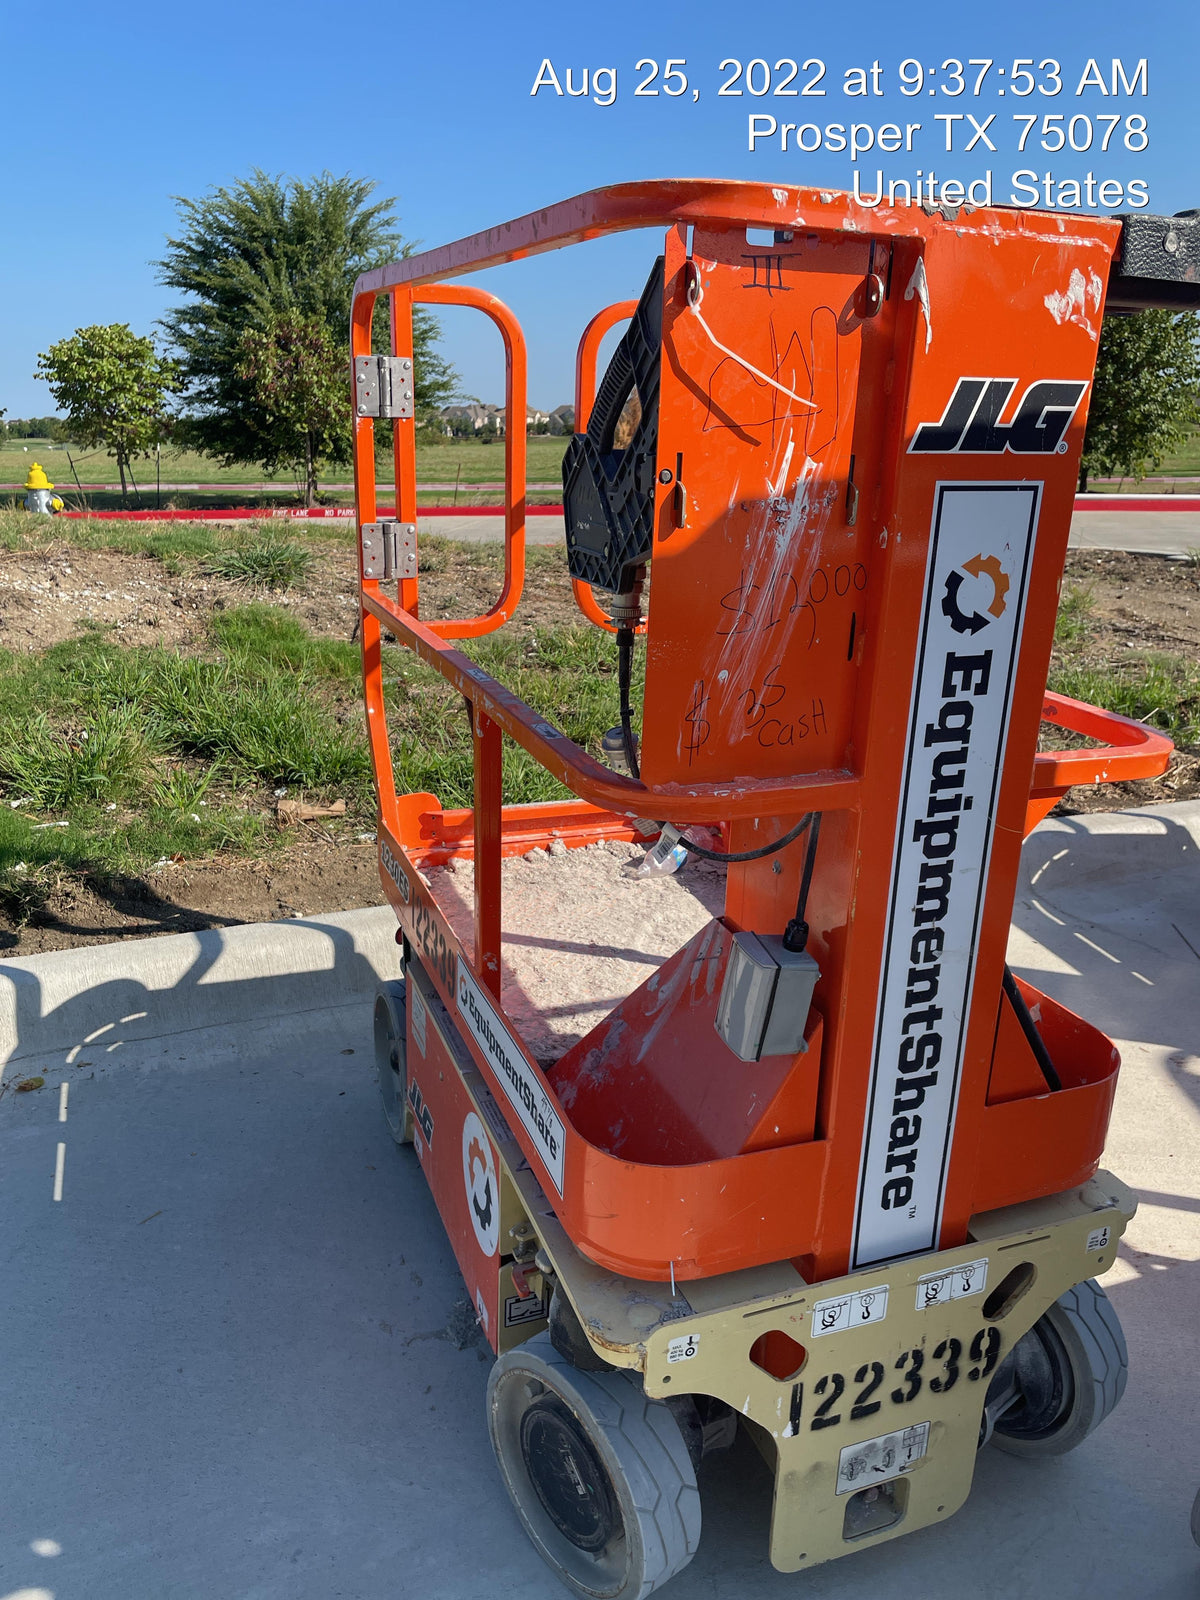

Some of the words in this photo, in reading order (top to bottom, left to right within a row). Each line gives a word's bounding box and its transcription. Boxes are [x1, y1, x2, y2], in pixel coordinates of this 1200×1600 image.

[906, 377, 1090, 454] JLG
[291, 509, 309, 517] LANE
[325, 509, 334, 517] NO
[881, 650, 994, 1210] EquipmentShare
[408, 1077, 434, 1151] JLG
[467, 991, 558, 1161] EquipmentShare
[789, 1326, 1001, 1437] 122339
